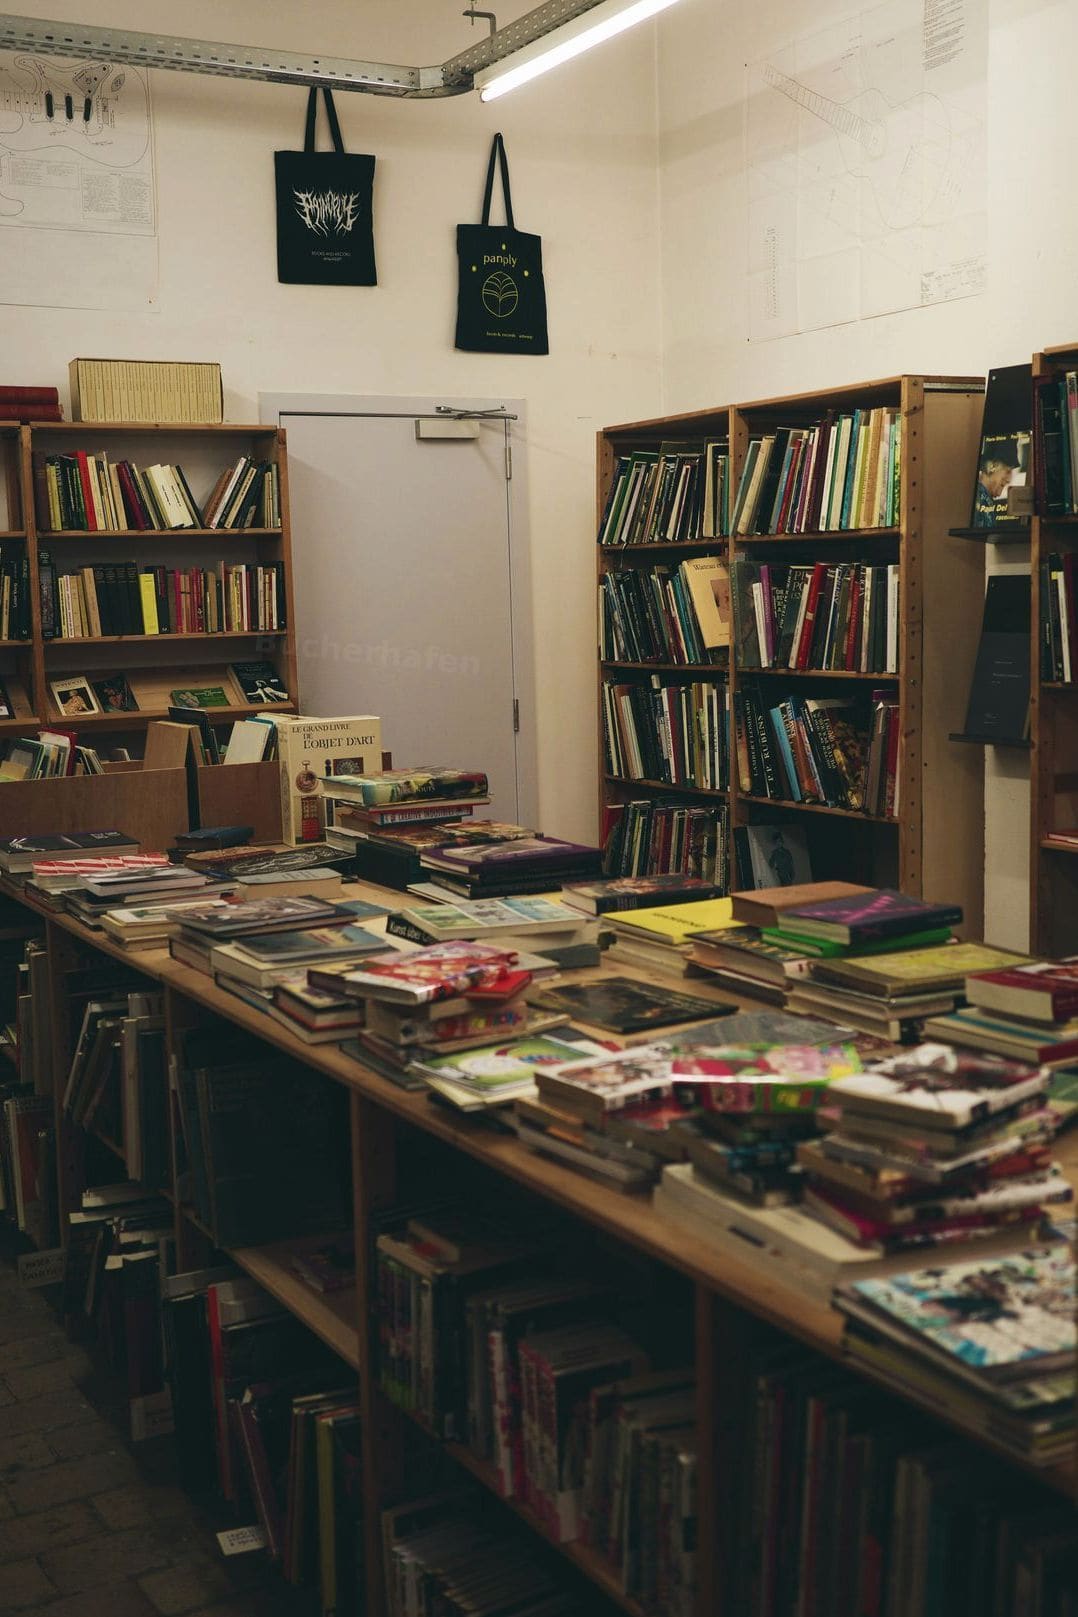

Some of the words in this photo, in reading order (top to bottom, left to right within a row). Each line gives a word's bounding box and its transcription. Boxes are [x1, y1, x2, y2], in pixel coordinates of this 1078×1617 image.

[292, 726, 302, 734] LE
[303, 724, 329, 733] GRAND
[329, 723, 350, 732] LIVRE
[303, 738, 342, 749] L'OBJET
[346, 736, 375, 746] D'ART
[757, 714, 770, 759] RUBENS
[390, 923, 407, 936] Kunst
